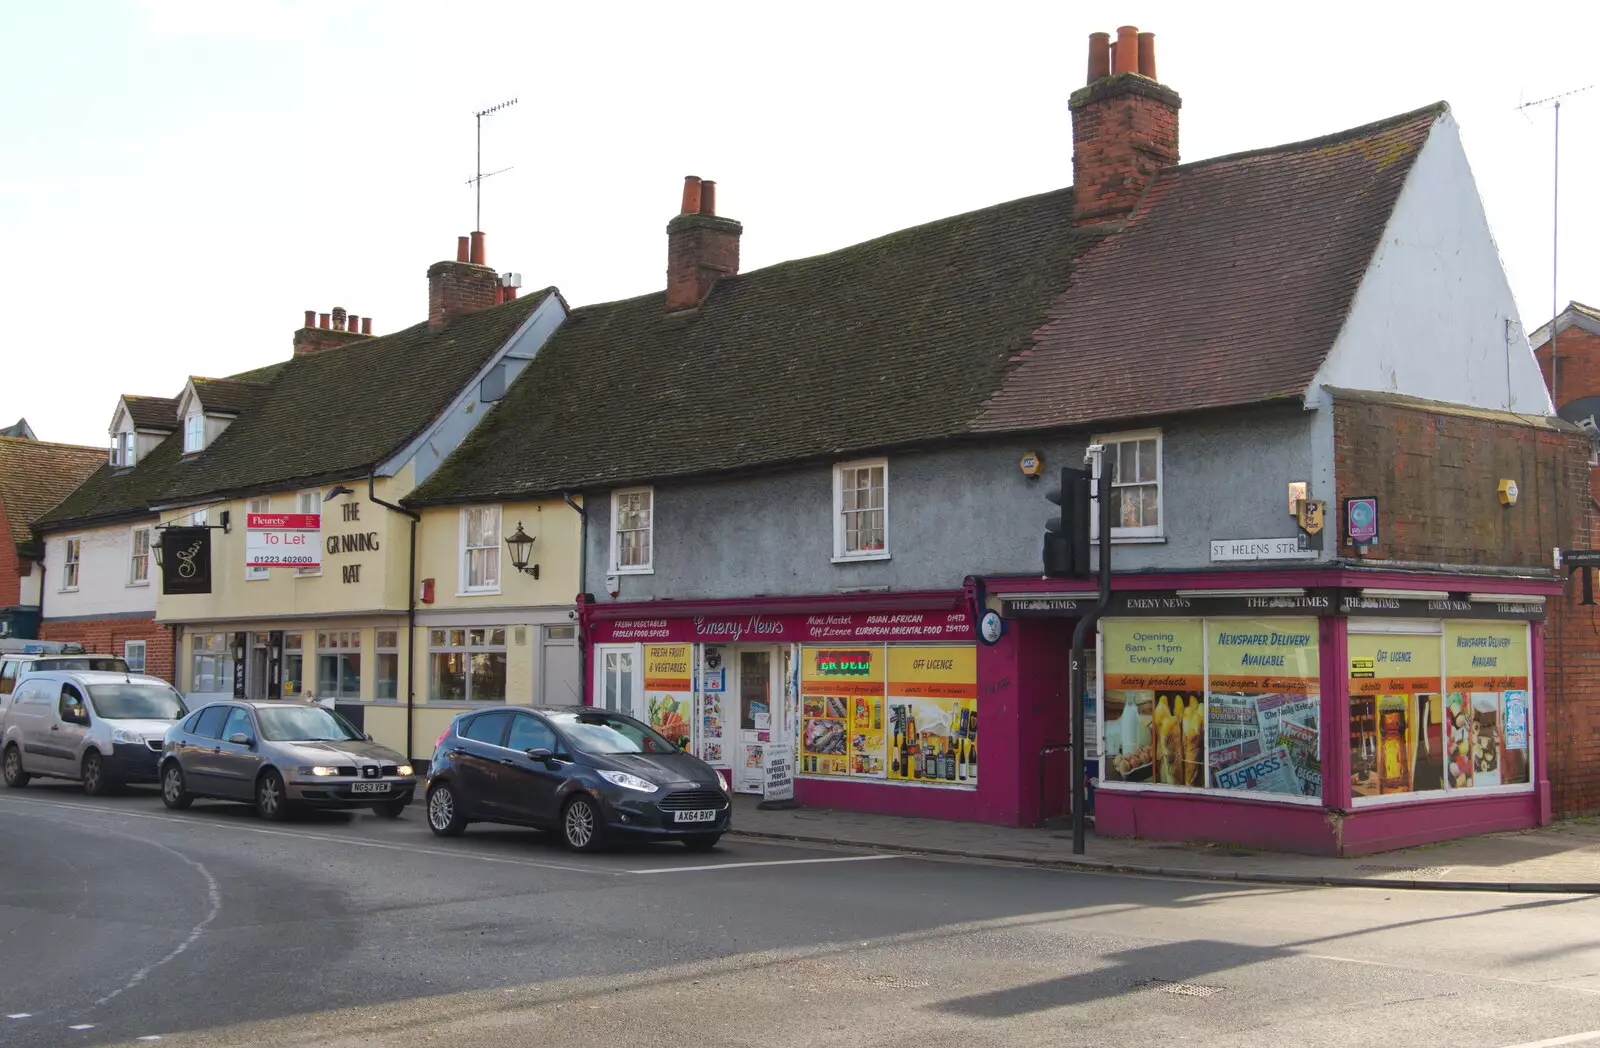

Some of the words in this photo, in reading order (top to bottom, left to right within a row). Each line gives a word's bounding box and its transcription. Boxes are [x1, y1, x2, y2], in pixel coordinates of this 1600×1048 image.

[341, 502, 360, 521] THE
[253, 516, 285, 525] Fleurets
[263, 532, 279, 545] To
[284, 532, 306, 545] Let
[1232, 543, 1269, 555] HELENS
[1276, 543, 1313, 554] STR
[254, 555, 280, 563] 01223
[282, 555, 313, 563] 402600
[342, 564, 361, 584] RAT
[1011, 600, 1029, 610] THE
[1050, 600, 1077, 610] TIMES
[1127, 599, 1160, 608] EMENY
[1162, 598, 1191, 608] NEWS
[1246, 598, 1268, 608] THE
[1295, 596, 1329, 607] TIMES
[1344, 597, 1361, 608] THE
[1378, 599, 1400, 609] TIMES
[1428, 600, 1452, 610] EMENY
[1453, 602, 1472, 611] NEWS
[1497, 603, 1511, 613] THE
[1525, 604, 1543, 613] TIMES
[614, 620, 632, 628] FRESH
[633, 620, 667, 628] VEGETABLES
[806, 616, 824, 625] Mini
[825, 615, 852, 625] Market
[694, 616, 742, 641] Emeny
[745, 615, 784, 634] News
[810, 627, 822, 637] Off
[822, 627, 852, 636] Licence
[923, 626, 942, 635] FOOD
[612, 629, 633, 638] FROZEN
[1133, 632, 1174, 642] Opening
[650, 647, 668, 658] FRESH
[668, 647, 686, 658] FRUIT
[1125, 643, 1146, 652] 6am
[1156, 644, 1182, 653] 11pm
[912, 659, 925, 670] OFF
[926, 659, 953, 670] LICENCE
[1072, 660, 1078, 670] 2
[1129, 655, 1175, 665] Everyday
[655, 662, 687, 673] VEGETABLES
[1121, 676, 1144, 688] dairy
[1147, 676, 1187, 686] products
[1210, 679, 1259, 689] newspapers
[1262, 678, 1270, 688] &
[1219, 757, 1281, 790] Business
[354, 783, 373, 792] NG53
[678, 811, 698, 821] AX64
[700, 810, 714, 820] BXP
